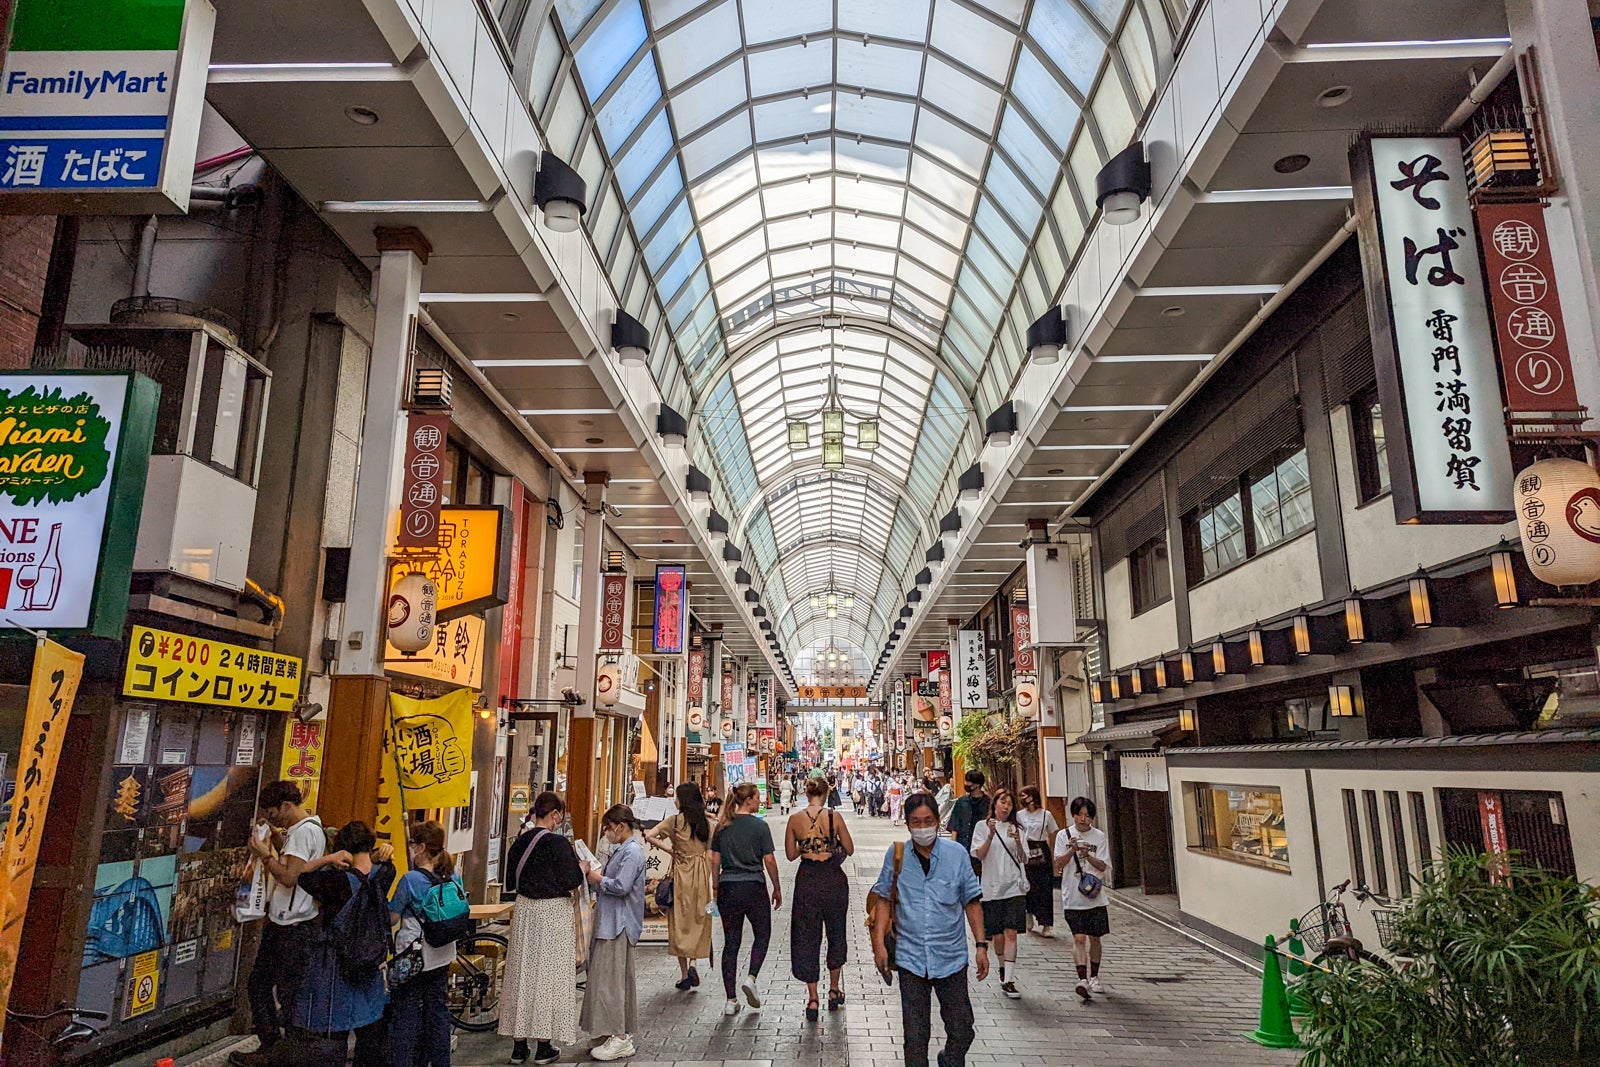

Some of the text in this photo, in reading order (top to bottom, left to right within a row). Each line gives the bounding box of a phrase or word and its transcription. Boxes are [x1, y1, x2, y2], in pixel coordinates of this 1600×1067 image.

[6, 70, 168, 99] FamilyMart
[1, 144, 148, 186] 酒 たばこ
[1390, 153, 1467, 288] そば
[1492, 219, 1564, 396] 観音通り
[0, 404, 89, 415] タとピザの店
[1425, 309, 1482, 491] 雷門満留賀
[406, 424, 441, 537] 観音通り
[1519, 473, 1556, 567] 観音通り
[456, 518, 469, 601] TORASUZU
[417, 584, 434, 640] 観音通り
[604, 581, 623, 644] 観音通り
[132, 663, 295, 706] コインロッカー
[158, 635, 298, 680] ¥200 24時間営業
[288, 721, 322, 815] 駅より
[407, 723, 435, 776] 酒場
[431, 721, 442, 771] TORASUZU
